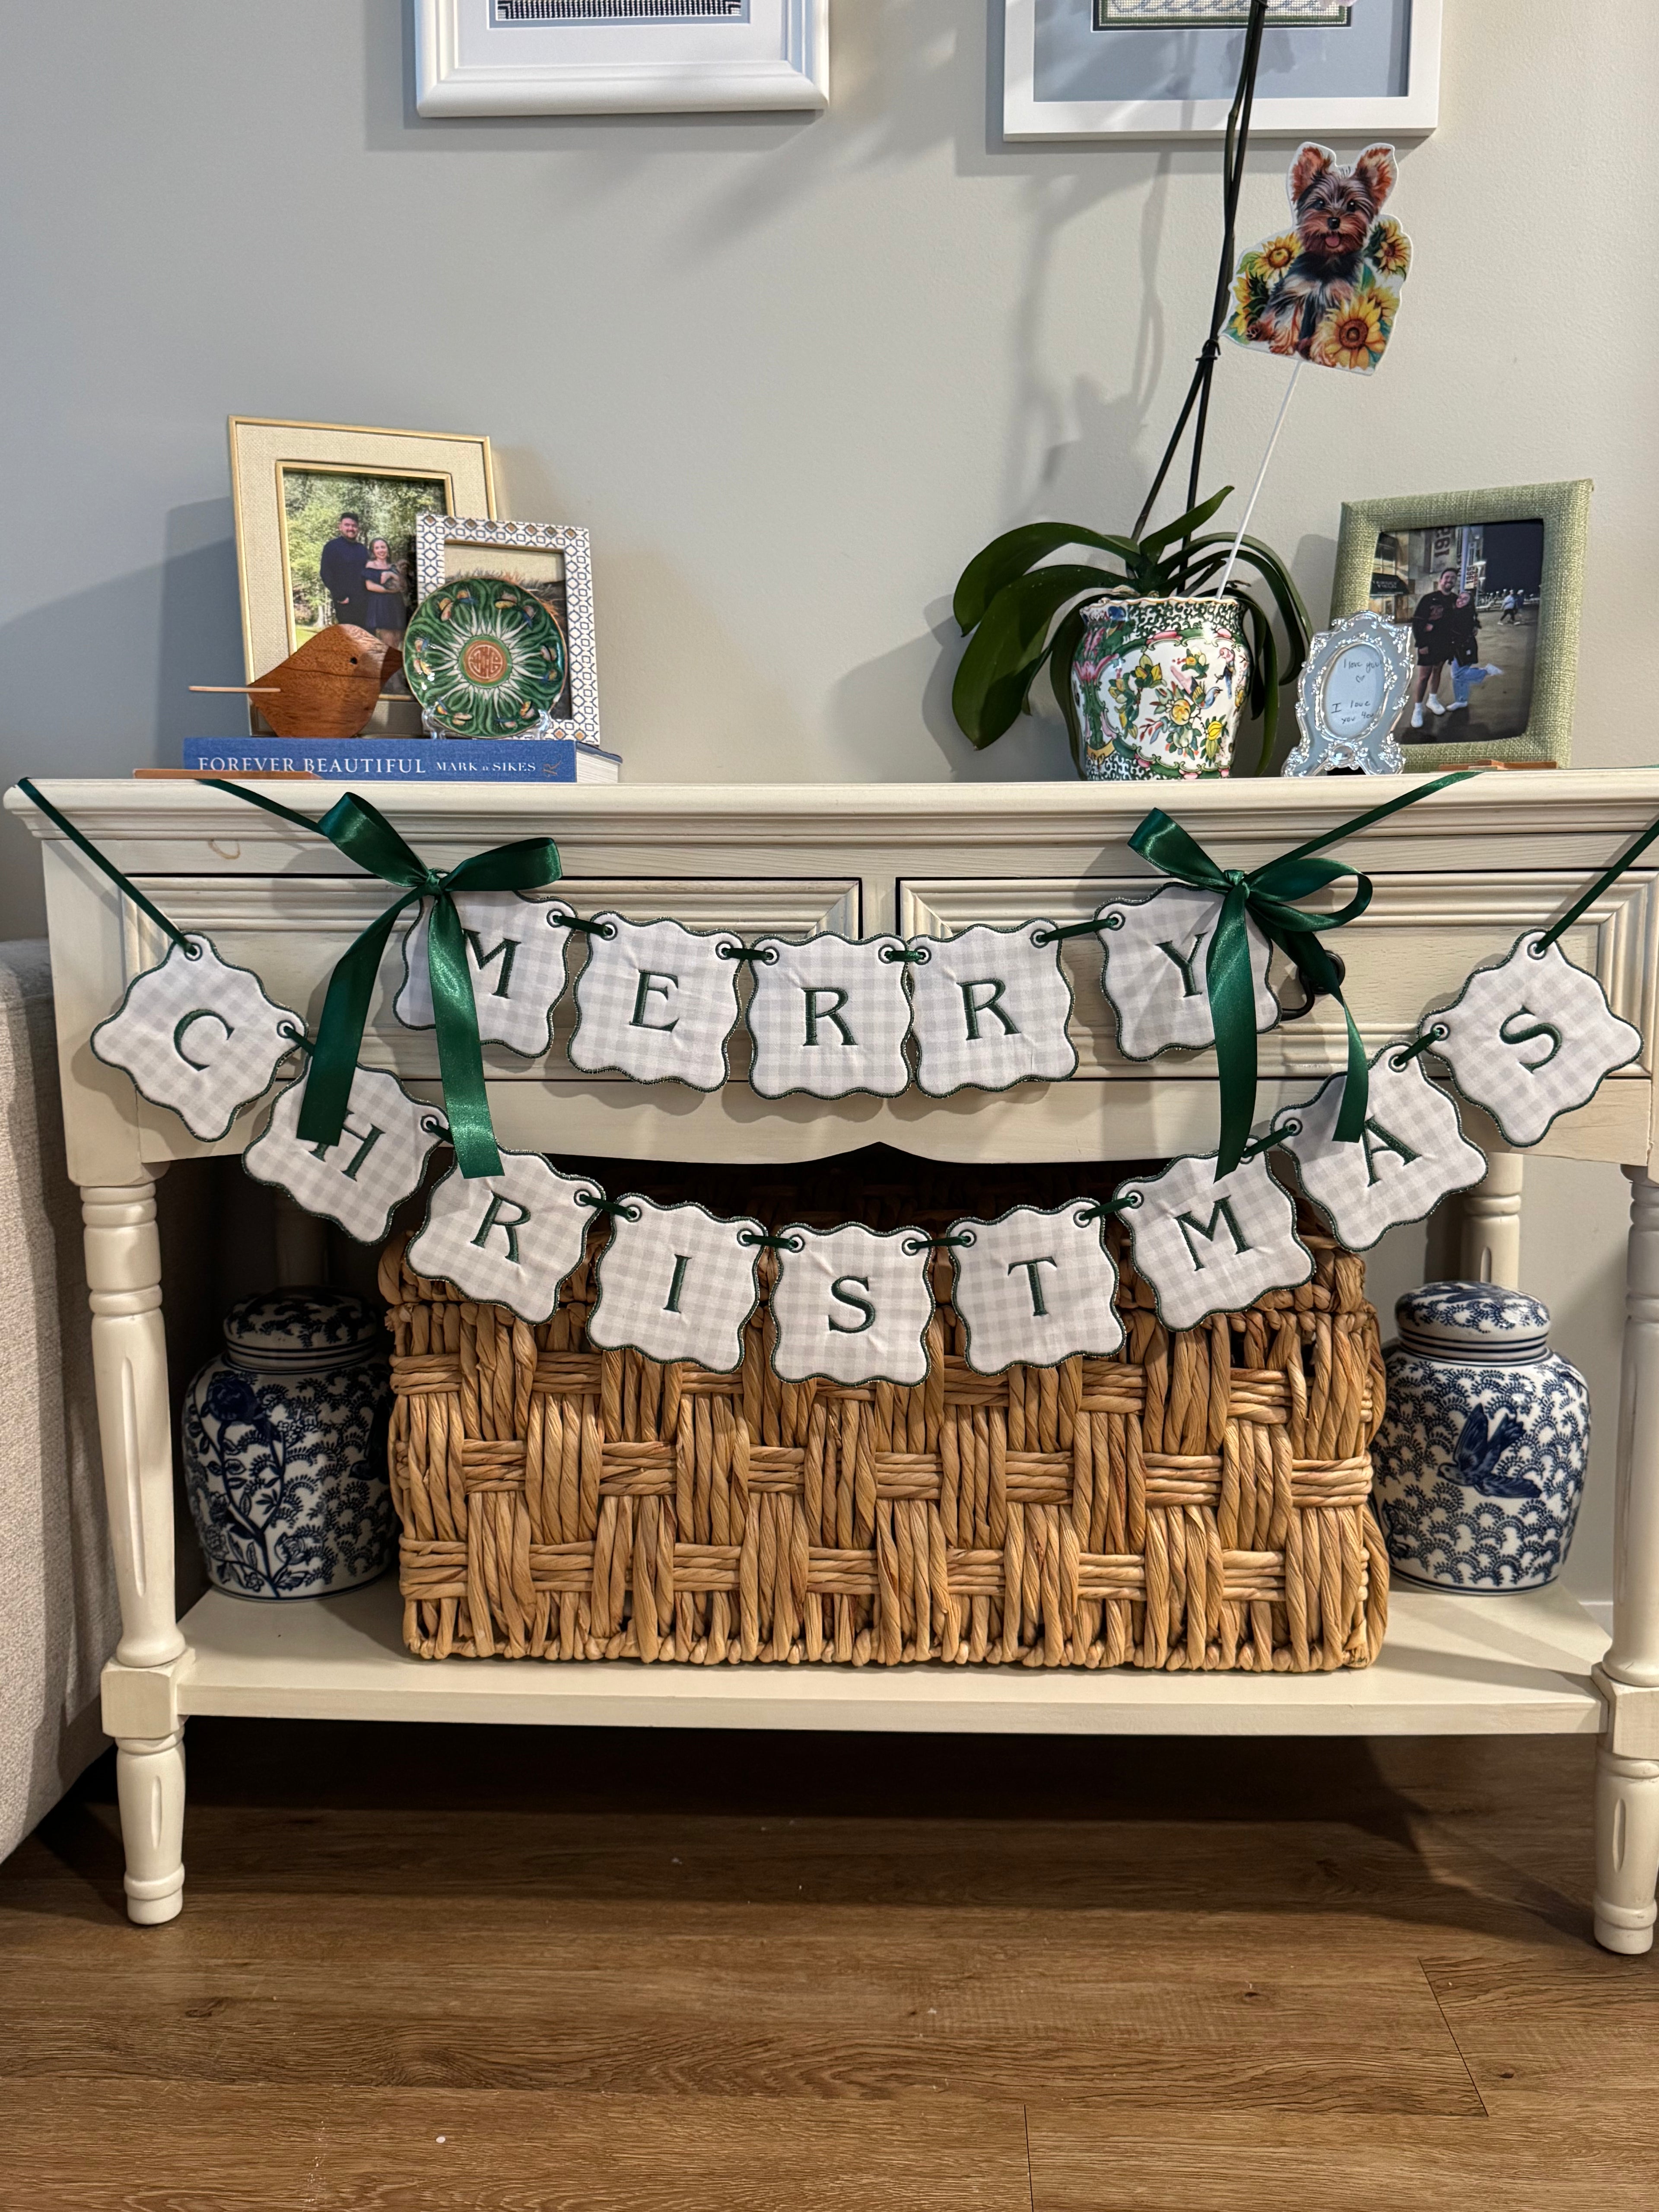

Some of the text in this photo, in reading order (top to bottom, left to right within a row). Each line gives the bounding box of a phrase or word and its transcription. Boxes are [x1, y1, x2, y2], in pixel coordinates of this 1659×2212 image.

[1348, 661, 1363, 670] love
[1331, 700, 1370, 714] I love
[1341, 716, 1356, 725] you
[197, 757, 295, 772] FOREVER
[303, 758, 426, 773] BEAUTIFUL
[436, 762, 478, 771] MARK
[492, 762, 536, 772] SIKES
